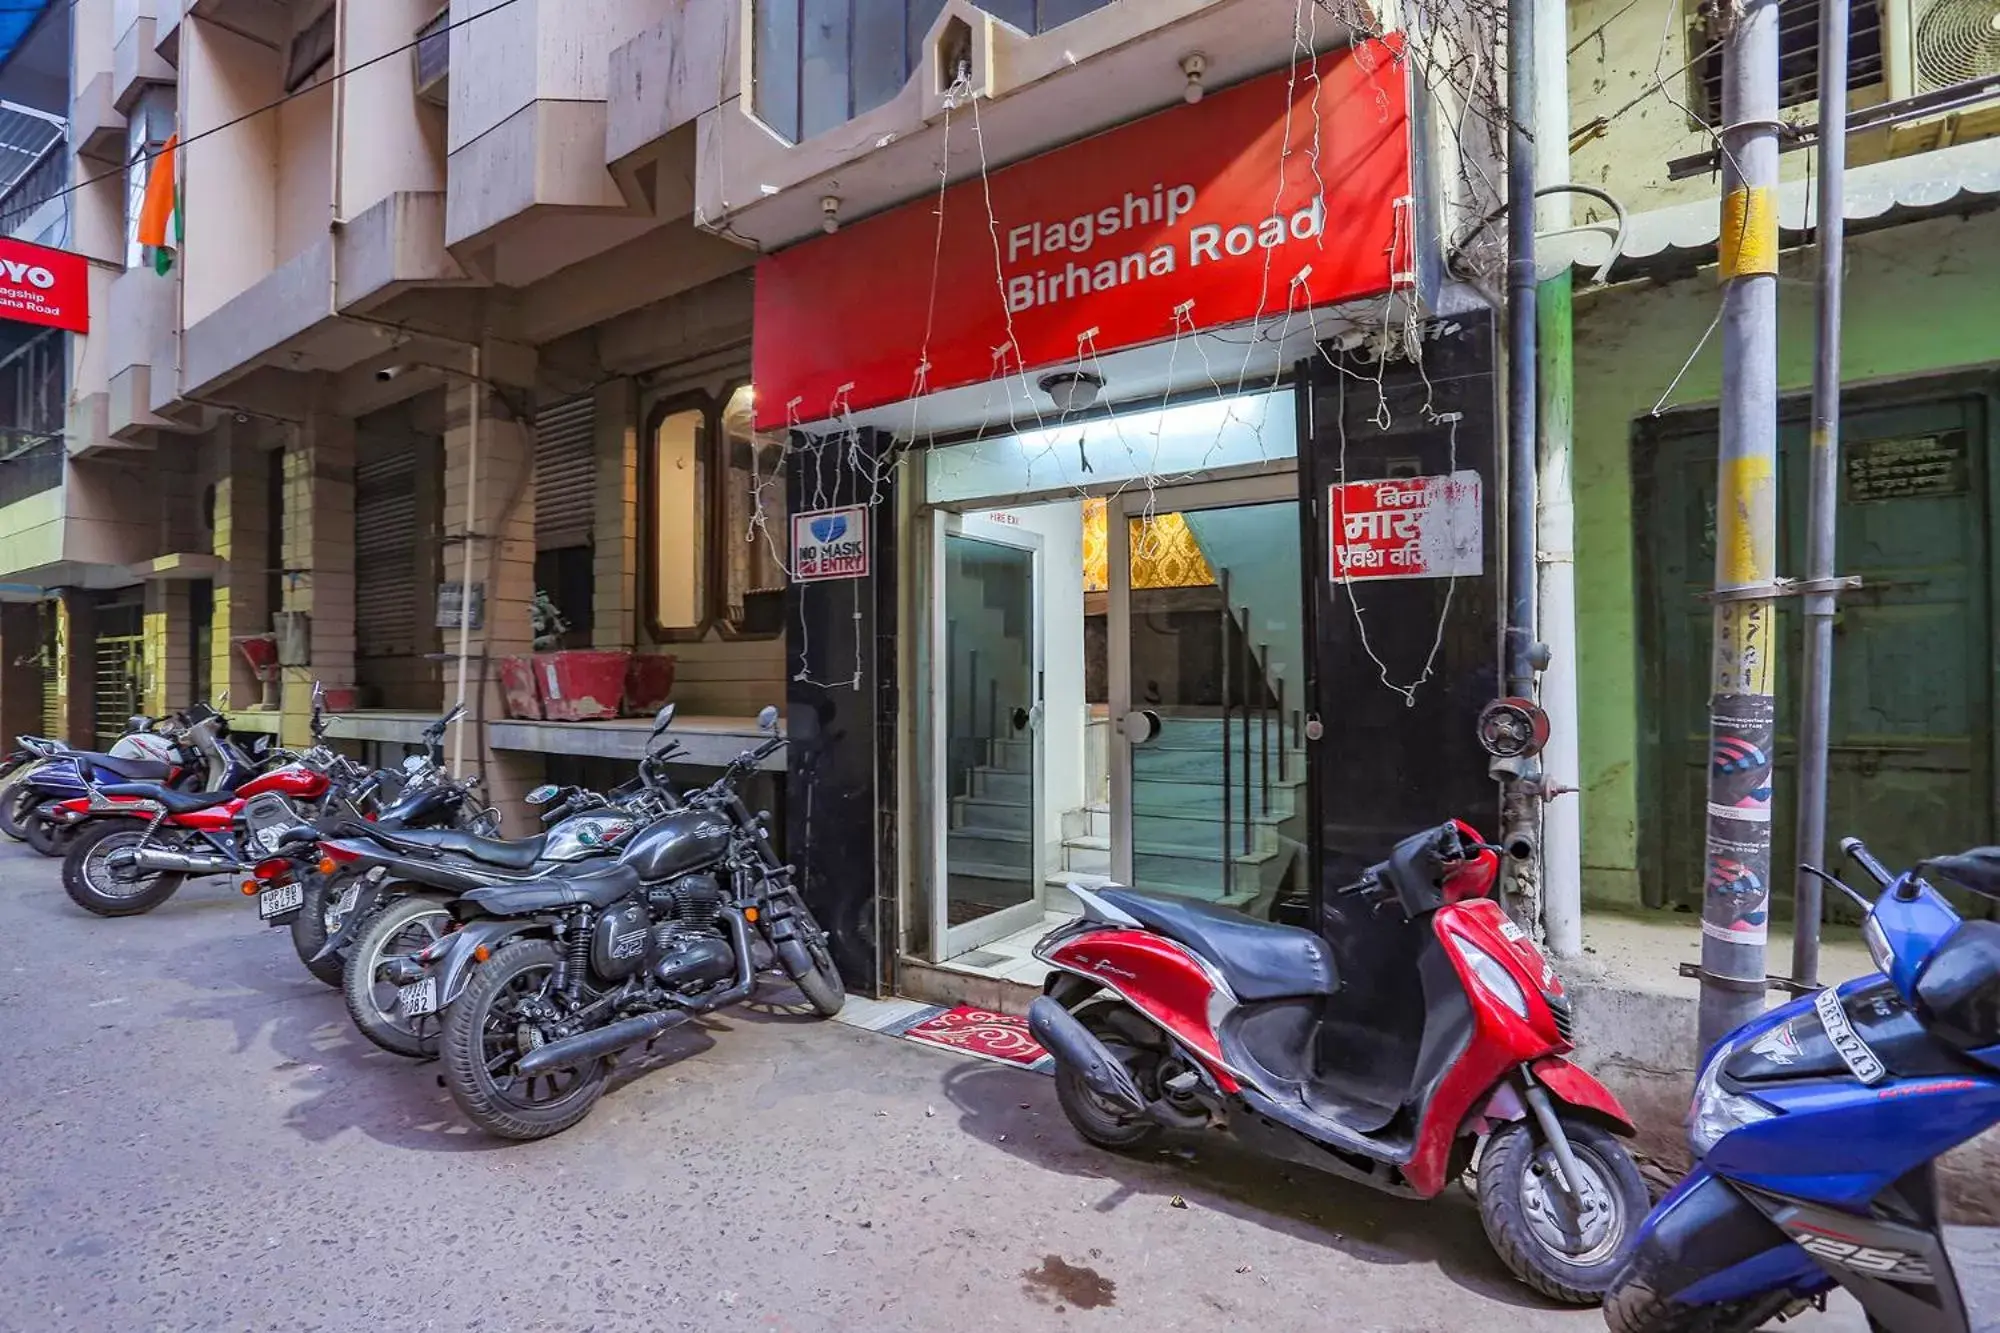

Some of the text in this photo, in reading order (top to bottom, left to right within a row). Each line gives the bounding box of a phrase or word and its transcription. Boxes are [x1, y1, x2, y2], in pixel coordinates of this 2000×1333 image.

[1008, 182, 1196, 263] Flagship
[1009, 195, 1324, 313] Birhana Road
[26, 301, 60, 316] Road
[800, 541, 863, 560] NO MASK
[821, 556, 864, 573] ENTRY
